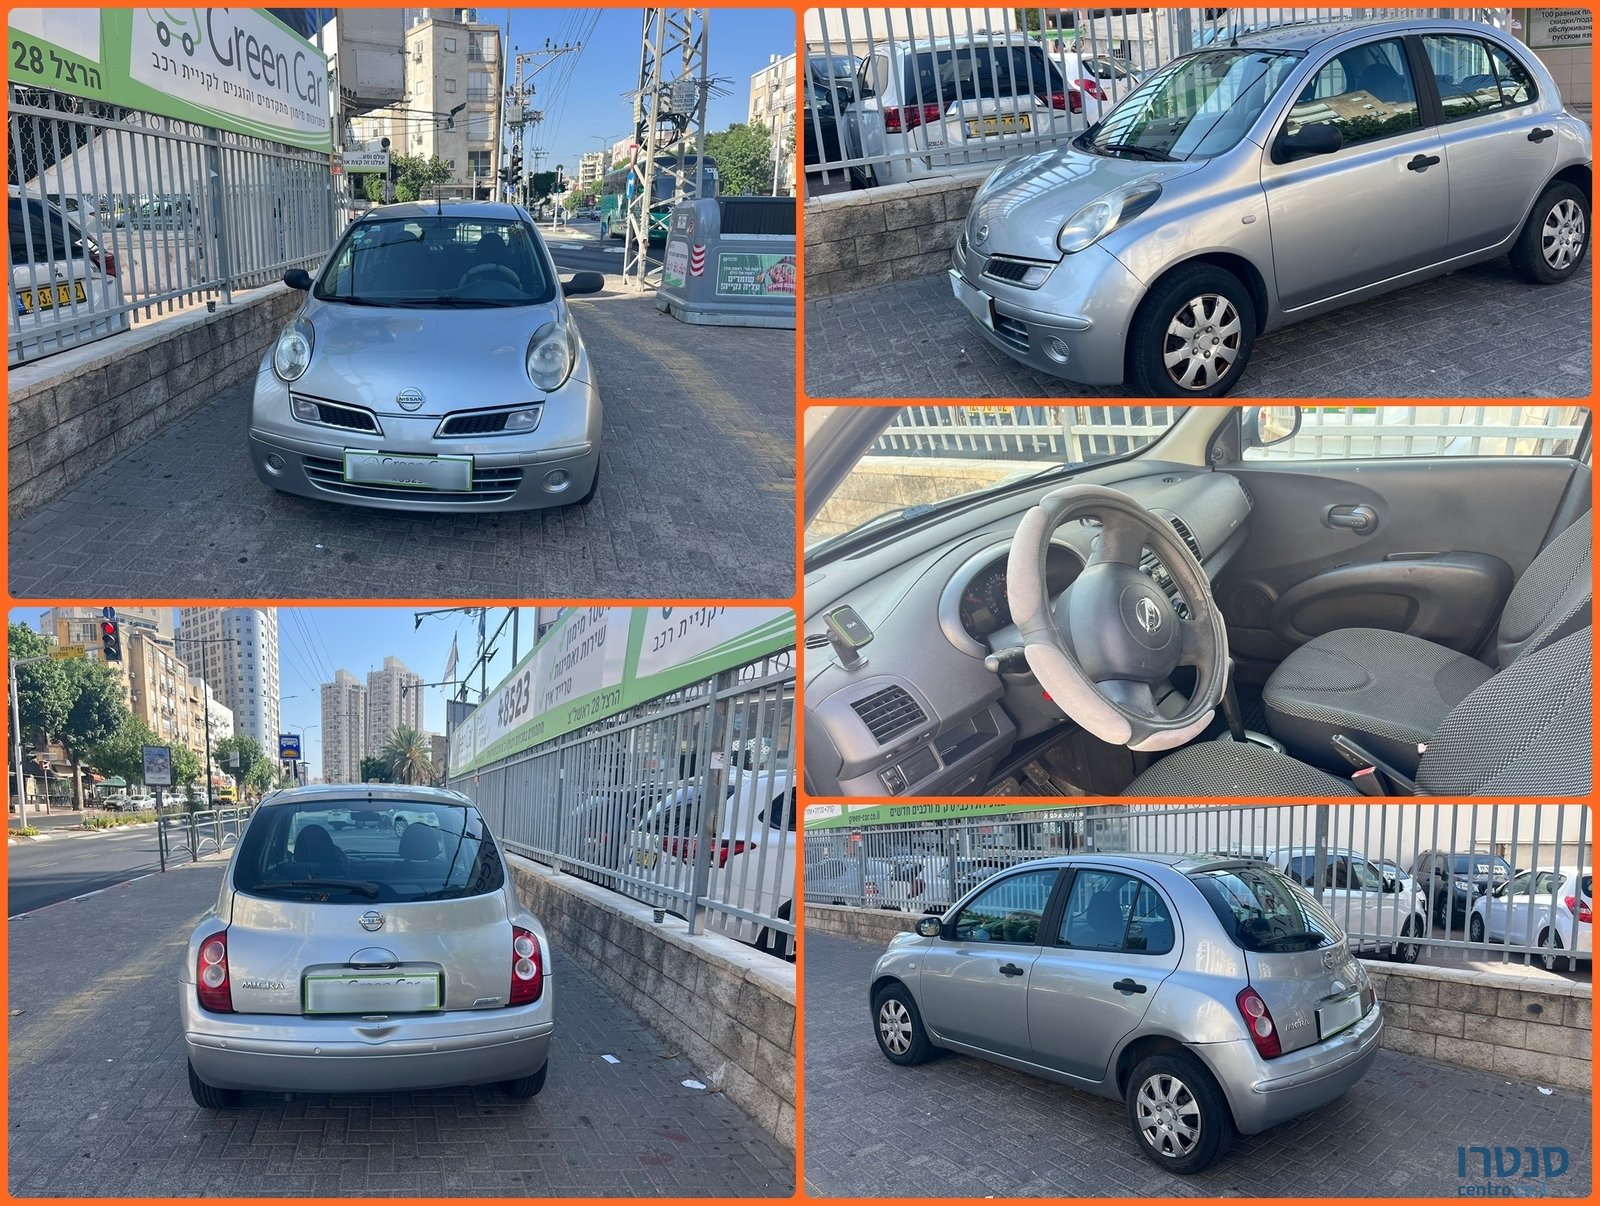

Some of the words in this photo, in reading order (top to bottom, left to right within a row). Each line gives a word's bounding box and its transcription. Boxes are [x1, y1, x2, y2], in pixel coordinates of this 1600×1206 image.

[1552, 33, 1580, 42] русском
[11, 40, 44, 75] 28
[49, 49, 102, 90] הרצל
[151, 51, 177, 75] רכב
[206, 8, 290, 94] Green
[293, 50, 323, 108] Car
[181, 63, 219, 92] לקניית
[223, 80, 255, 104] והוגנים
[257, 93, 289, 114] מתקדמים
[580, 624, 607, 662] שירות
[652, 627, 674, 653] רכב
[590, 696, 600, 715] 28
[601, 689, 620, 711] הרצל
[848, 810, 881, 824] green-car.co.il
[890, 807, 911, 817] חדשים
[242, 981, 286, 990] MICRA
